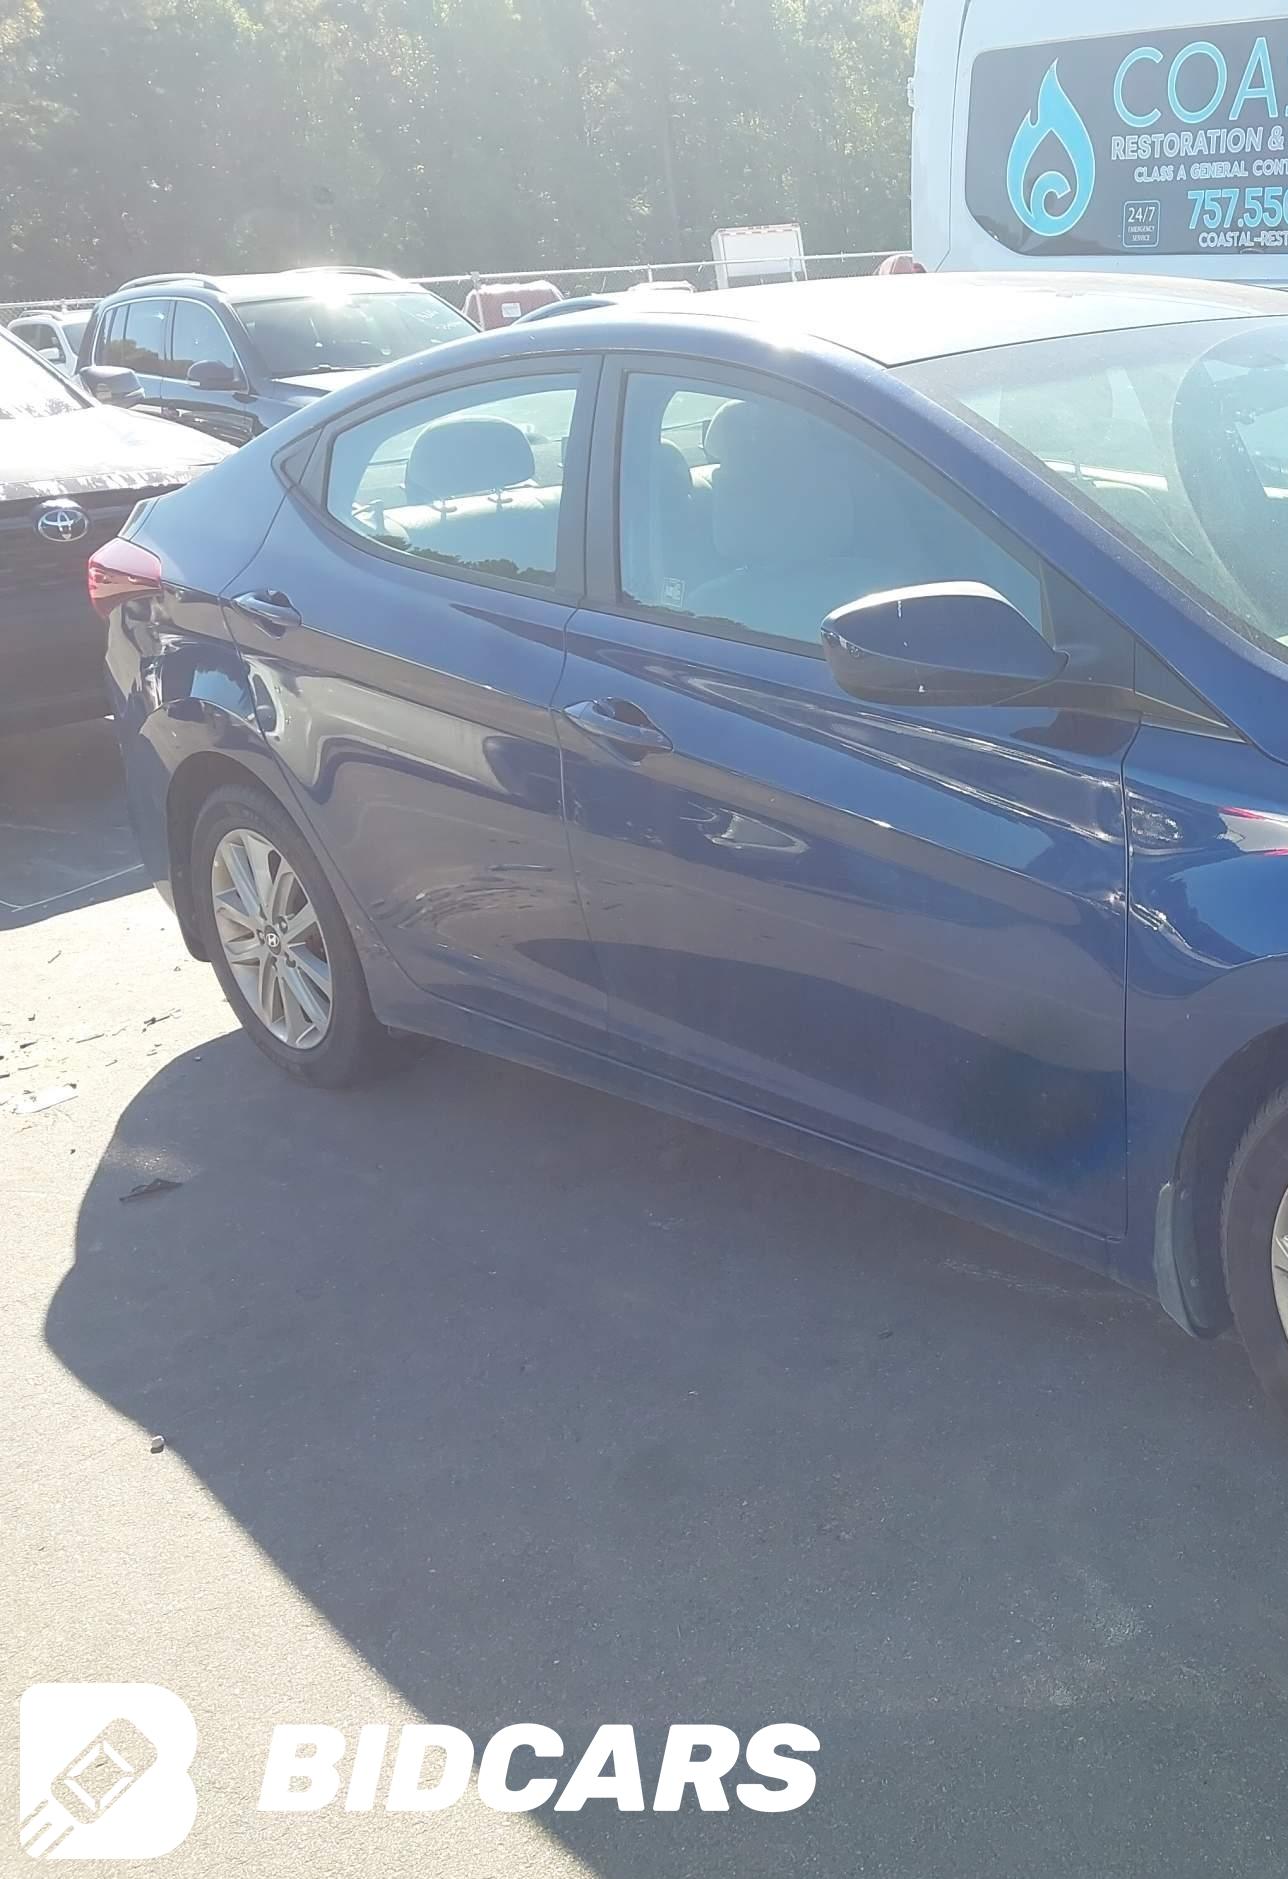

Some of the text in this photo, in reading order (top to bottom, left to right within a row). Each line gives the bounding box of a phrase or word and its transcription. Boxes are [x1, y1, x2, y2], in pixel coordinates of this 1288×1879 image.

[1111, 127, 1264, 160] RESTORATION
[1267, 125, 1285, 151] &
[1133, 166, 1174, 183] CLASS
[1176, 164, 1187, 181] A
[1190, 160, 1249, 180] GENERAL
[1127, 206, 1156, 223] 24/7
